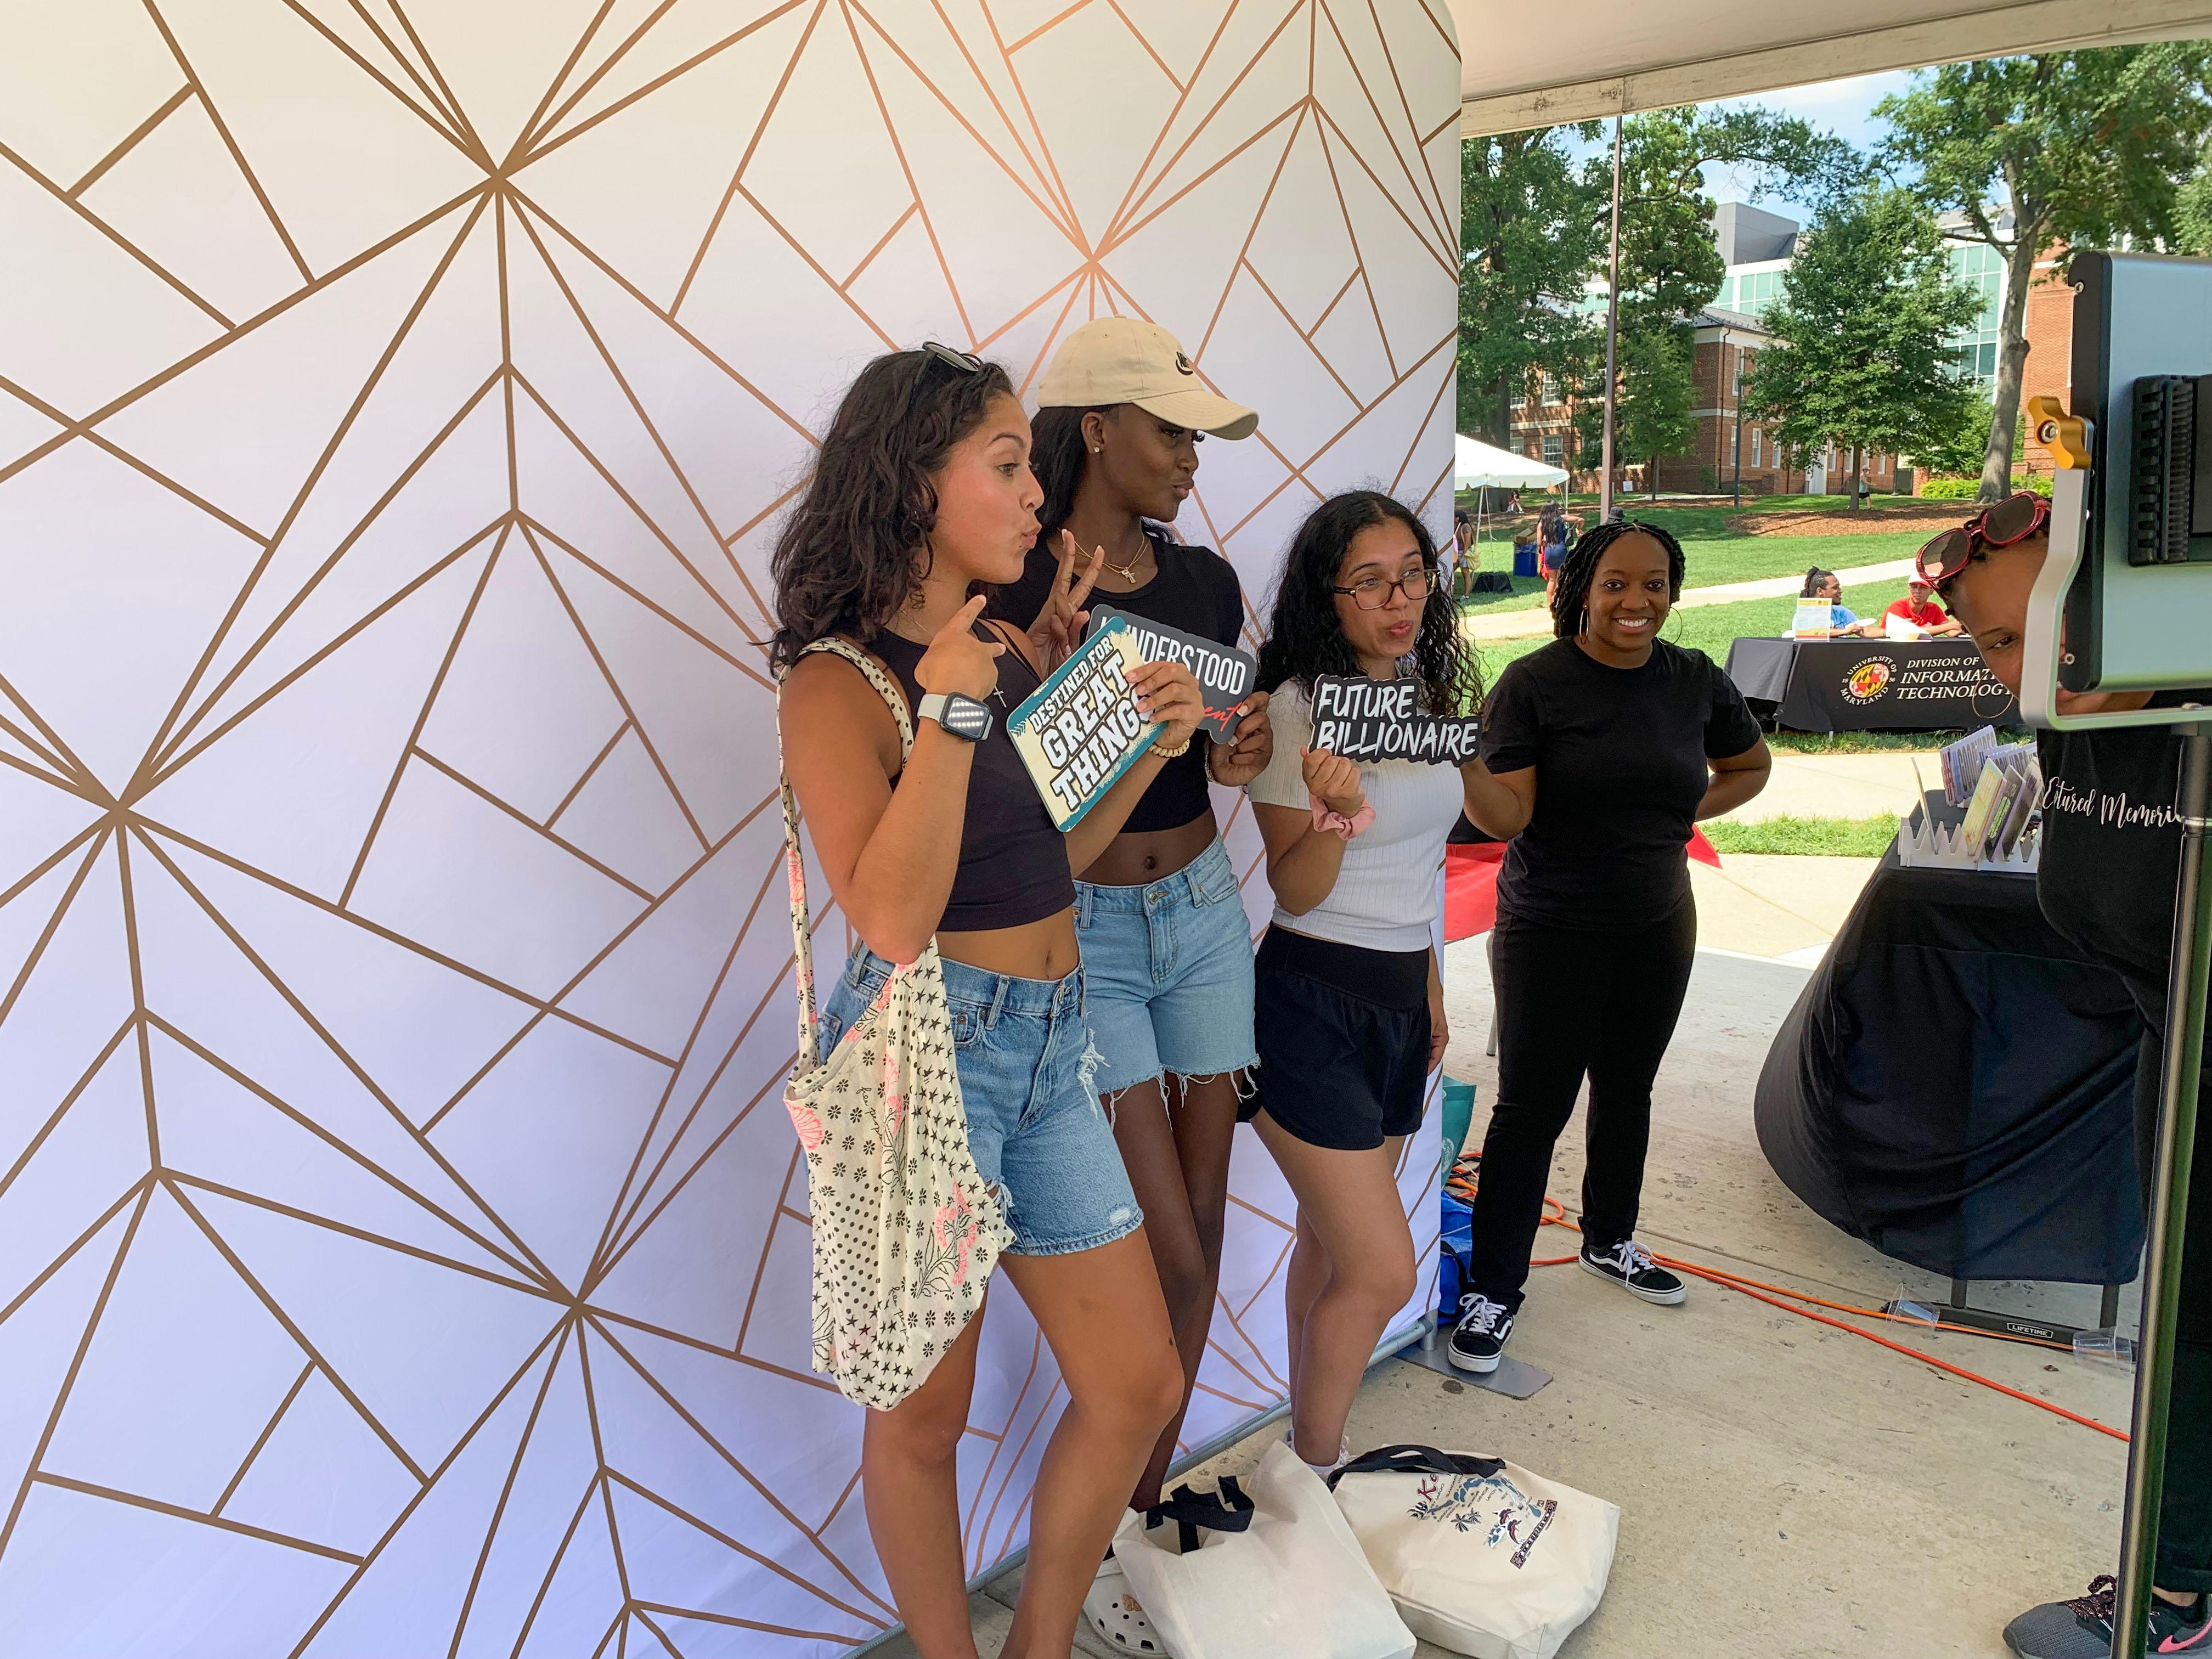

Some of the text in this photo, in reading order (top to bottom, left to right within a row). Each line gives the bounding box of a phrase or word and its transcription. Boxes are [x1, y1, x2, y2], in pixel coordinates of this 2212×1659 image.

[1100, 616, 1245, 696] NDERSTOOD
[1847, 656, 1897, 675] UNIVERSITY OF
[1906, 657, 1980, 669] DIVISION OF
[1029, 635, 1114, 735] DESTINED FOR
[1900, 668, 1996, 684] INFORMATI
[1041, 648, 1129, 770] GREAT
[1317, 682, 1415, 724] FUTURE
[1840, 687, 1888, 706] MARYLAND
[1316, 720, 1479, 760] BILLIONAIRE
[2101, 793, 2183, 829] Memori
[2012, 1325, 2048, 1336] LIFETIME
